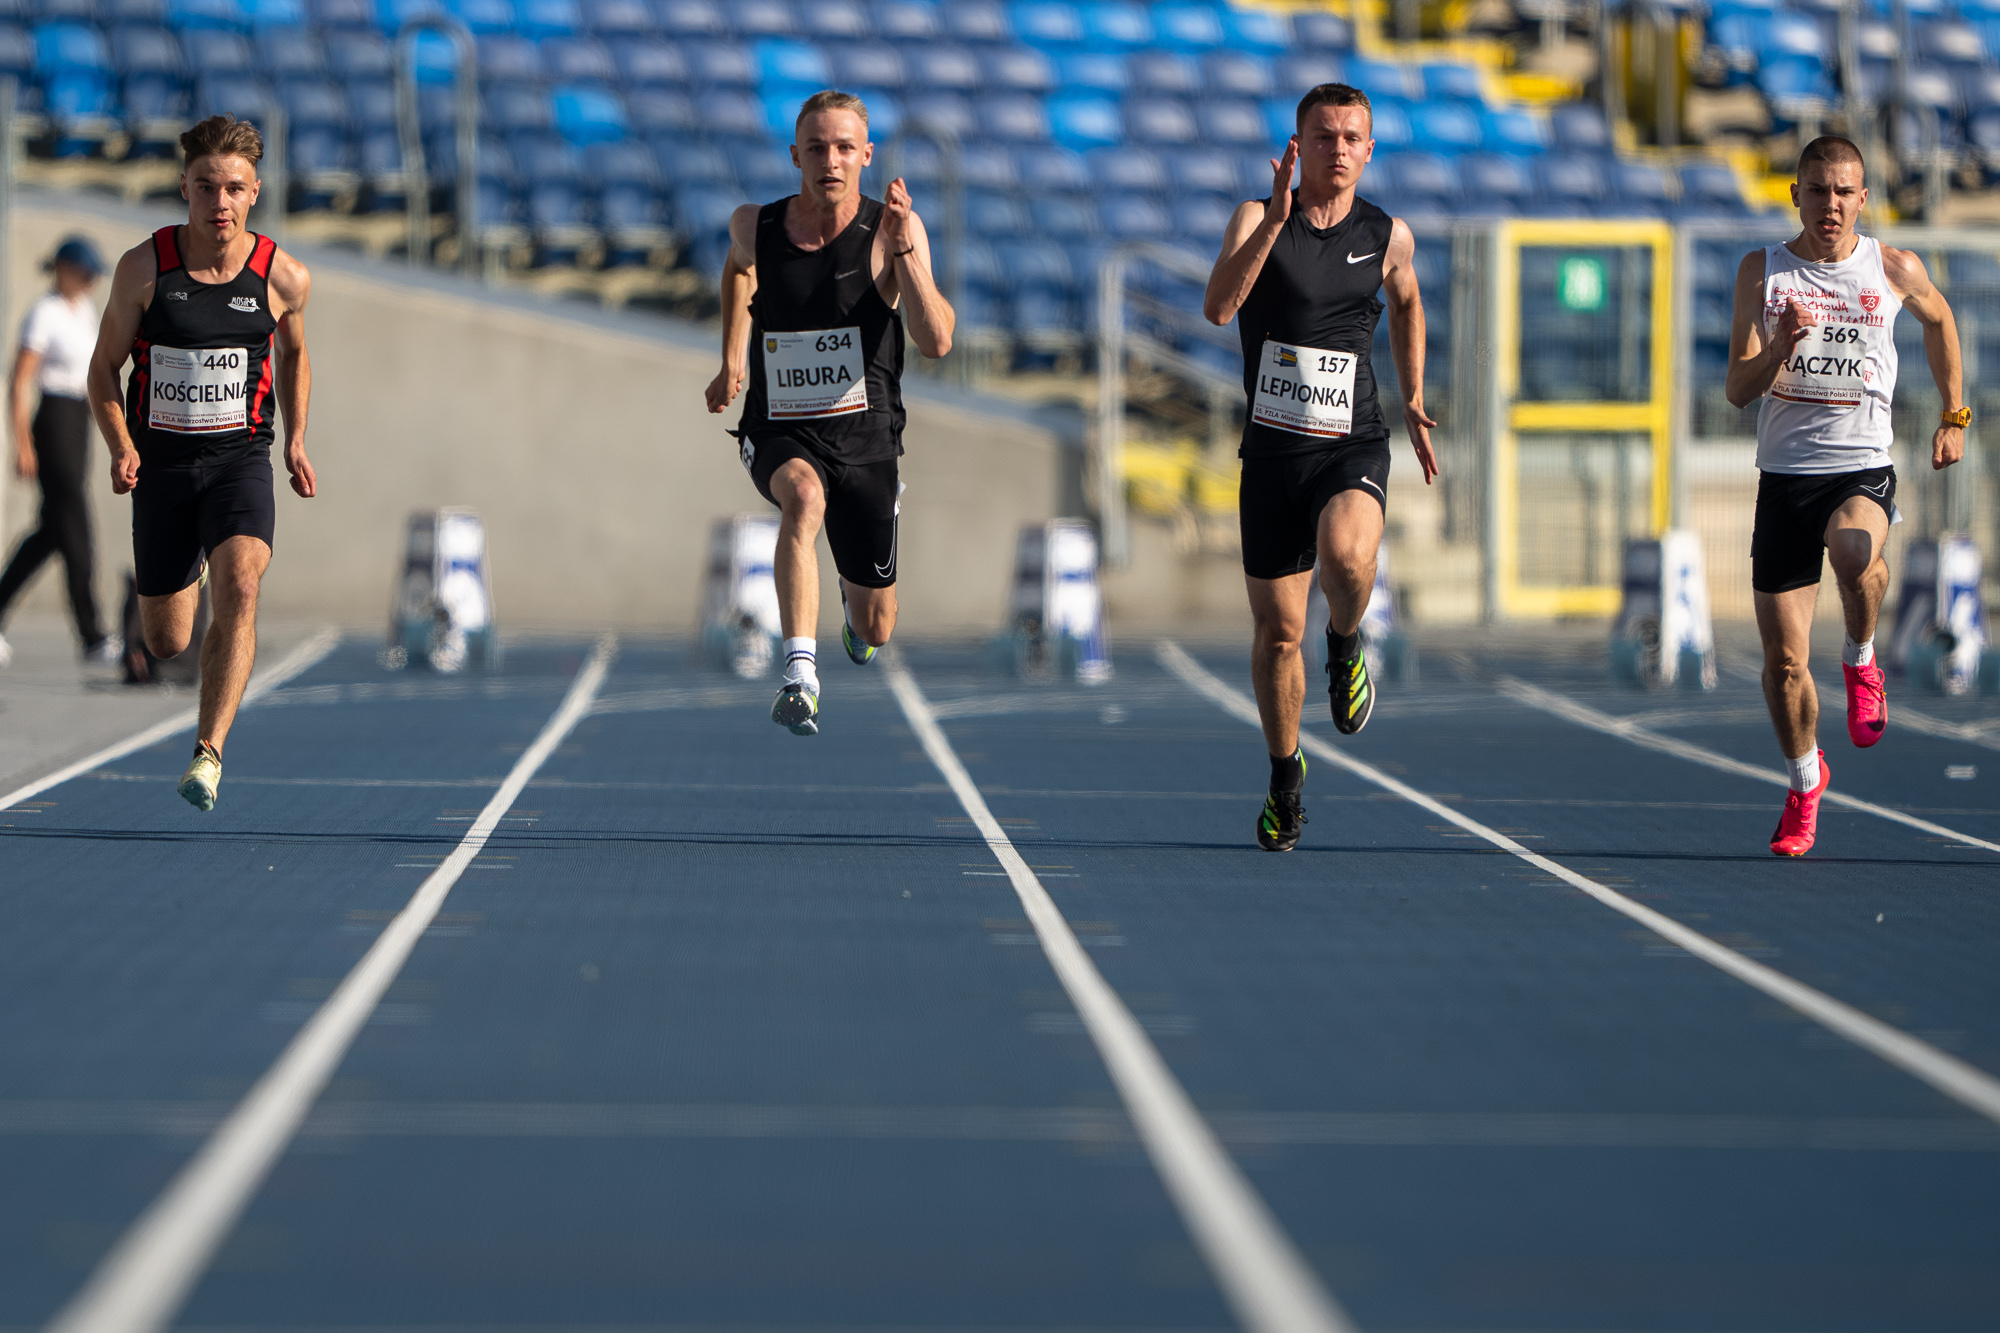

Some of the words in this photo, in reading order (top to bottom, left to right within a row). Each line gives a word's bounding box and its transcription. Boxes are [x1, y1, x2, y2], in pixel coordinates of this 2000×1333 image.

[1765, 299, 1849, 313] CZOCHOWA
[815, 333, 852, 352] 634
[1822, 326, 1859, 344] 569
[203, 353, 239, 370] 440
[1318, 355, 1349, 374] 157
[777, 364, 852, 388] LIBURA
[154, 380, 247, 403] KOŚCIELNIA
[1260, 374, 1349, 409] LEPIONKA
[1791, 388, 1828, 397] Mistrzostwa
[1829, 390, 1848, 398] Polski
[794, 400, 832, 409] Mistrzostwa
[833, 396, 852, 406] Polski
[853, 394, 865, 402] U18
[151, 413, 160, 421] 55.
[162, 415, 176, 423] PZLA
[177, 416, 214, 424] Mistrzostwa
[215, 414, 233, 423] Polski
[1255, 407, 1264, 415] 55.
[1264, 409, 1279, 419] PZLA
[1280, 413, 1317, 427] Mistrzostwa
[1318, 420, 1337, 429] Polski
[1337, 422, 1350, 430] U18
